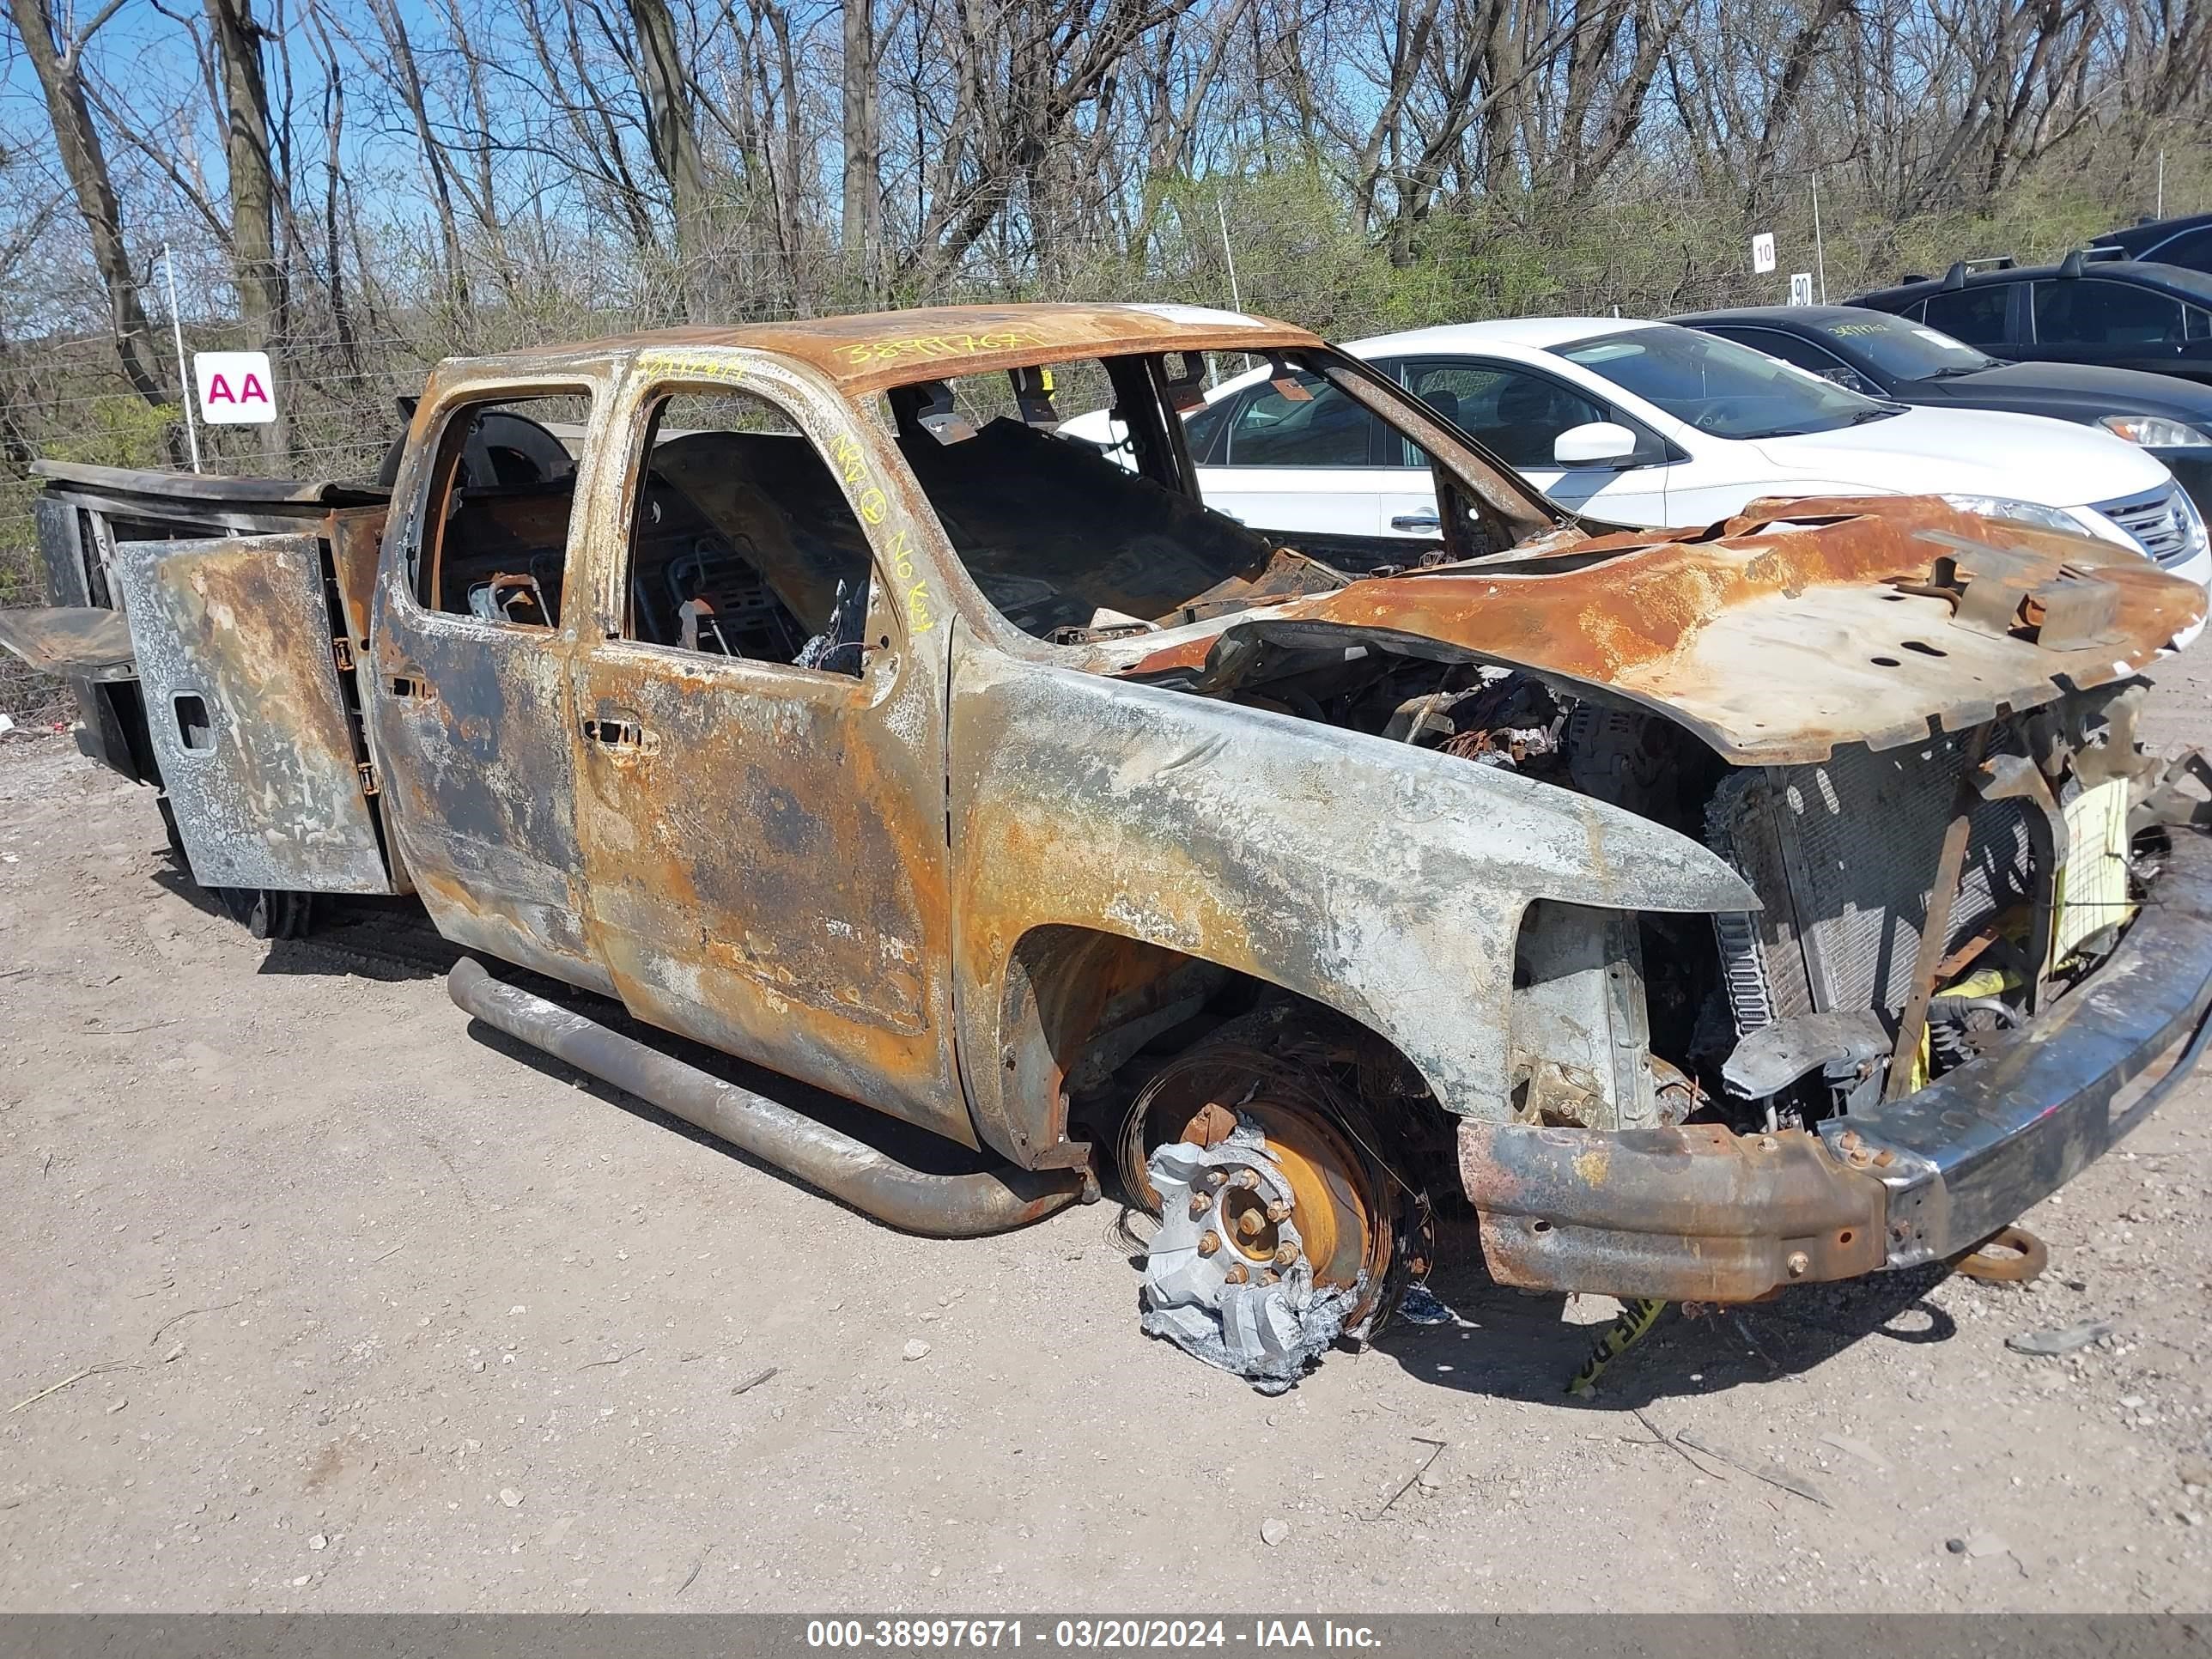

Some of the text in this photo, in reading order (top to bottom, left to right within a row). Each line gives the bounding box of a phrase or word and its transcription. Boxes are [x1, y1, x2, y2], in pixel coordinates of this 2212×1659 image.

[1757, 244, 1771, 263] 10
[1795, 277, 1808, 306] 90
[832, 333, 1048, 364] 38997671
[208, 373, 269, 404] AA
